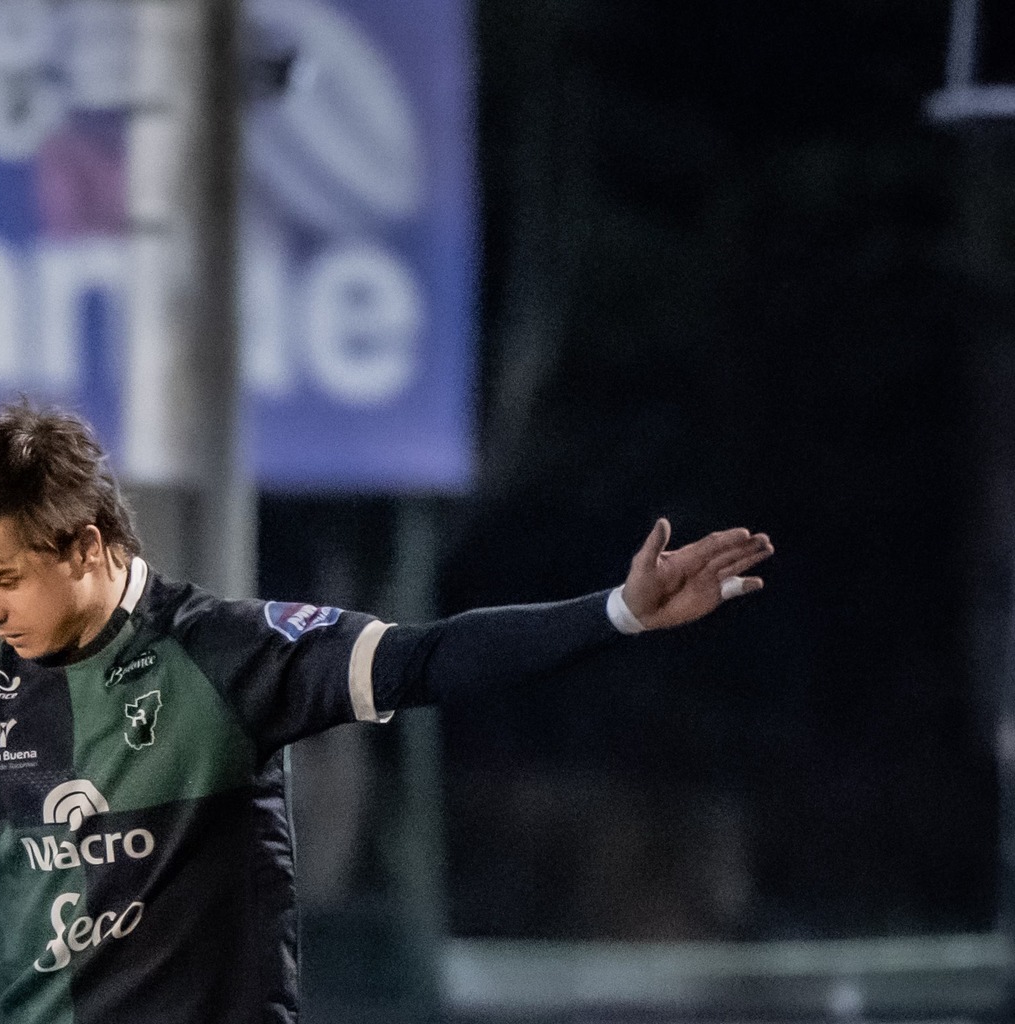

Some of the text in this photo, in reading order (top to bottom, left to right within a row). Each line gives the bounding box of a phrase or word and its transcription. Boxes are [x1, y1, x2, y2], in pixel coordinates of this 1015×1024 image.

[3, 750, 38, 761] Buena
[21, 828, 156, 872] Macro
[34, 892, 145, 973] Seco
